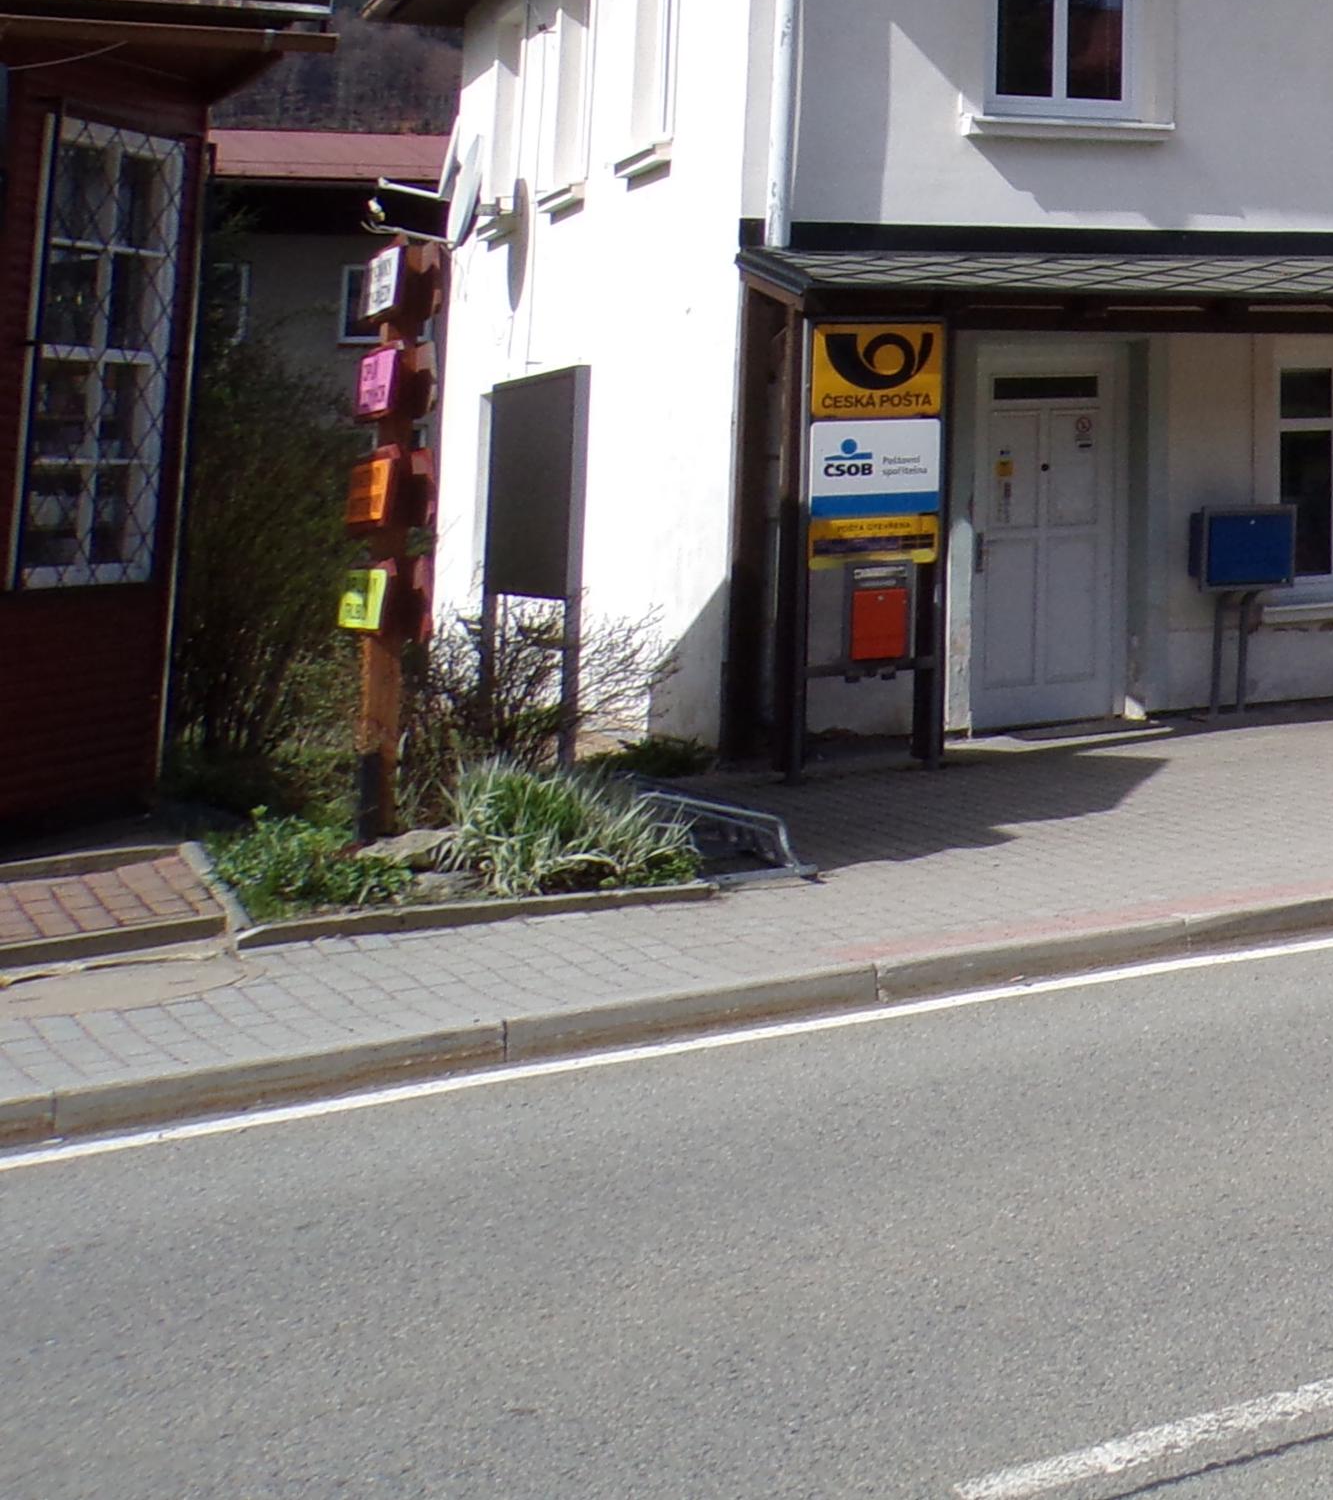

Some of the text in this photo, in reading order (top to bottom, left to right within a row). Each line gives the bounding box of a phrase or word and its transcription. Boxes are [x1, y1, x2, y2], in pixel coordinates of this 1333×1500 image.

[821, 391, 932, 409] ČESKÁ POŠTA
[823, 463, 873, 477] ČSOB
